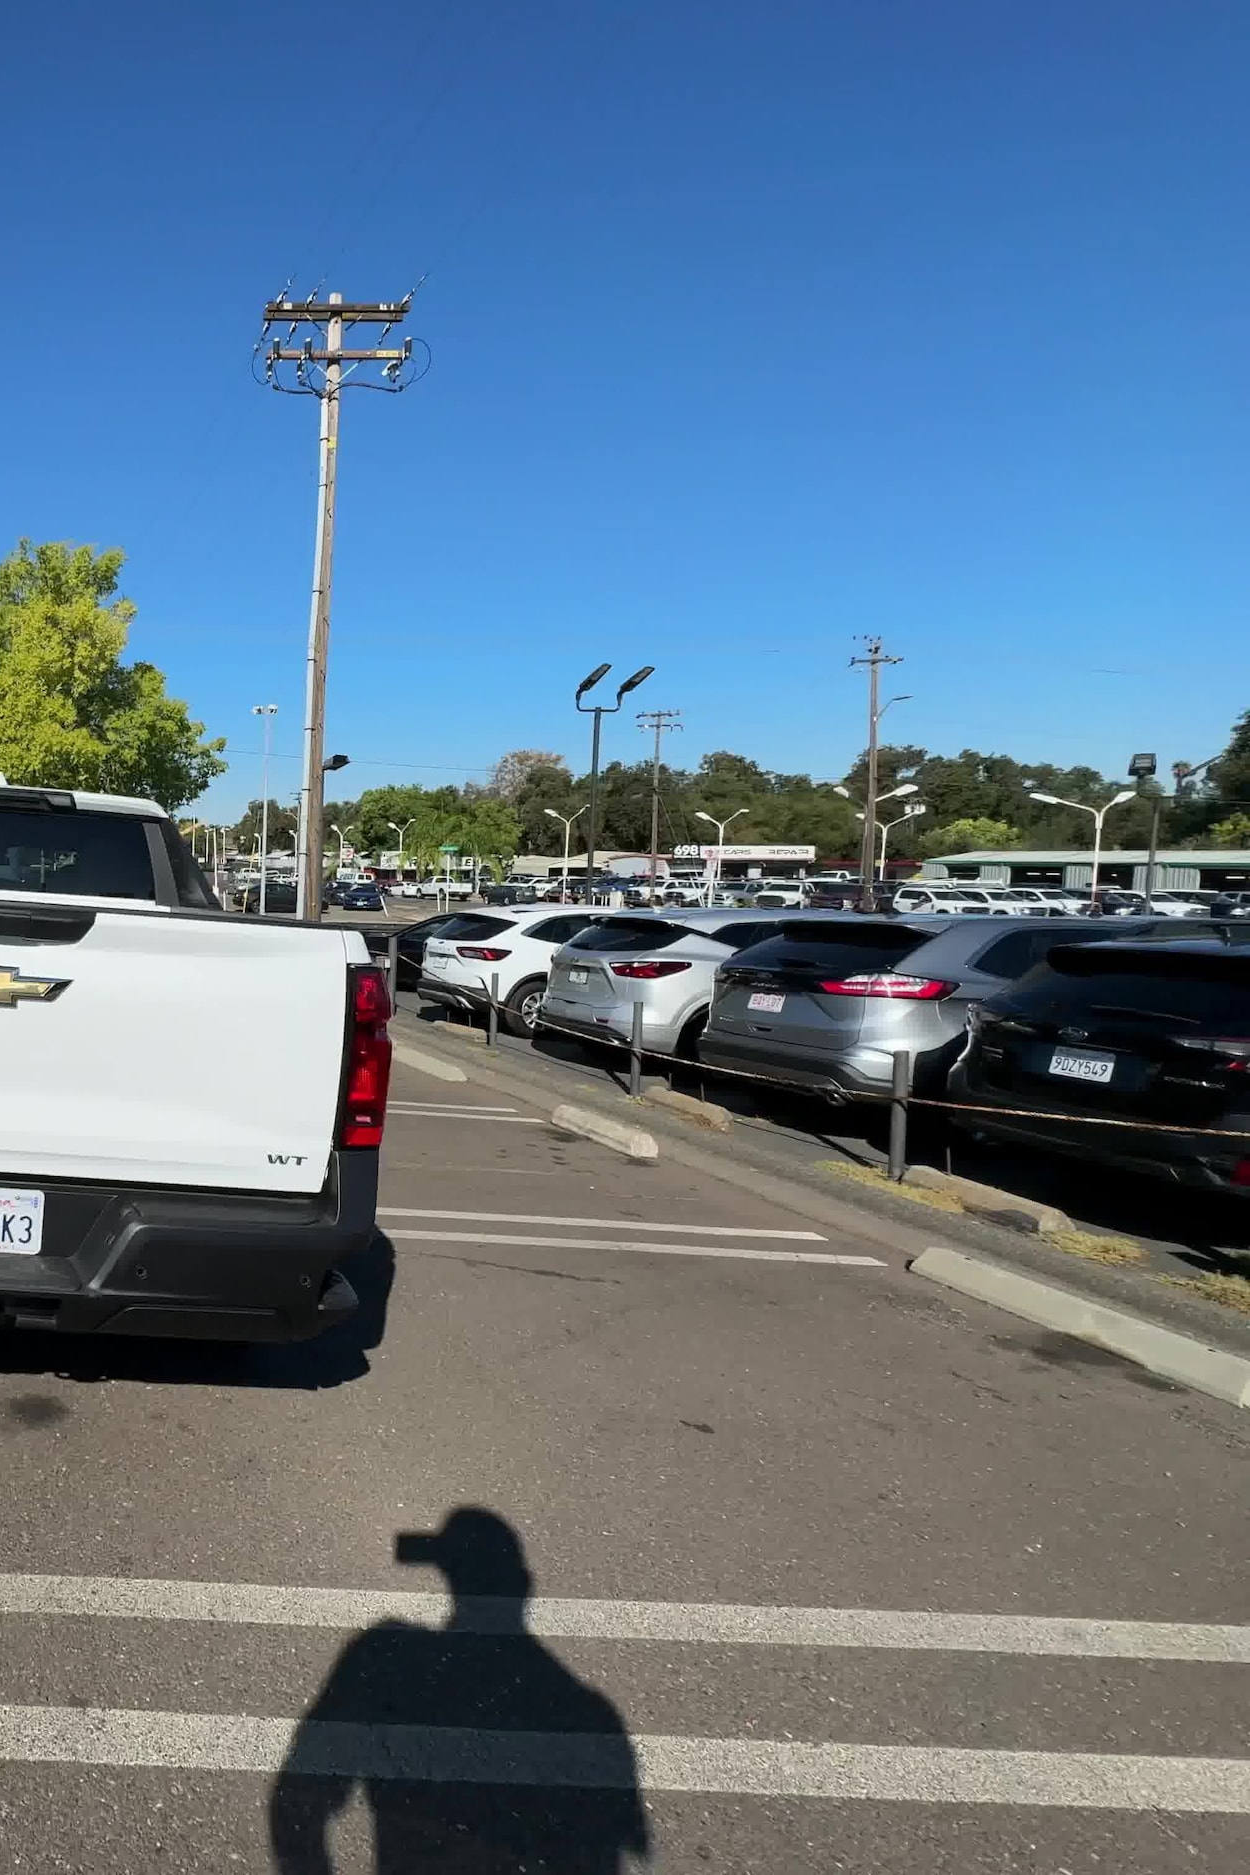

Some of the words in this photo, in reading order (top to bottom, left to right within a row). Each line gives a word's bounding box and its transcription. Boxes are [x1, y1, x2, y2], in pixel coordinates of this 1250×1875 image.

[674, 844, 699, 856] 698
[1053, 1057, 1108, 1077] 9DZY549
[267, 1154, 308, 1166] WT
